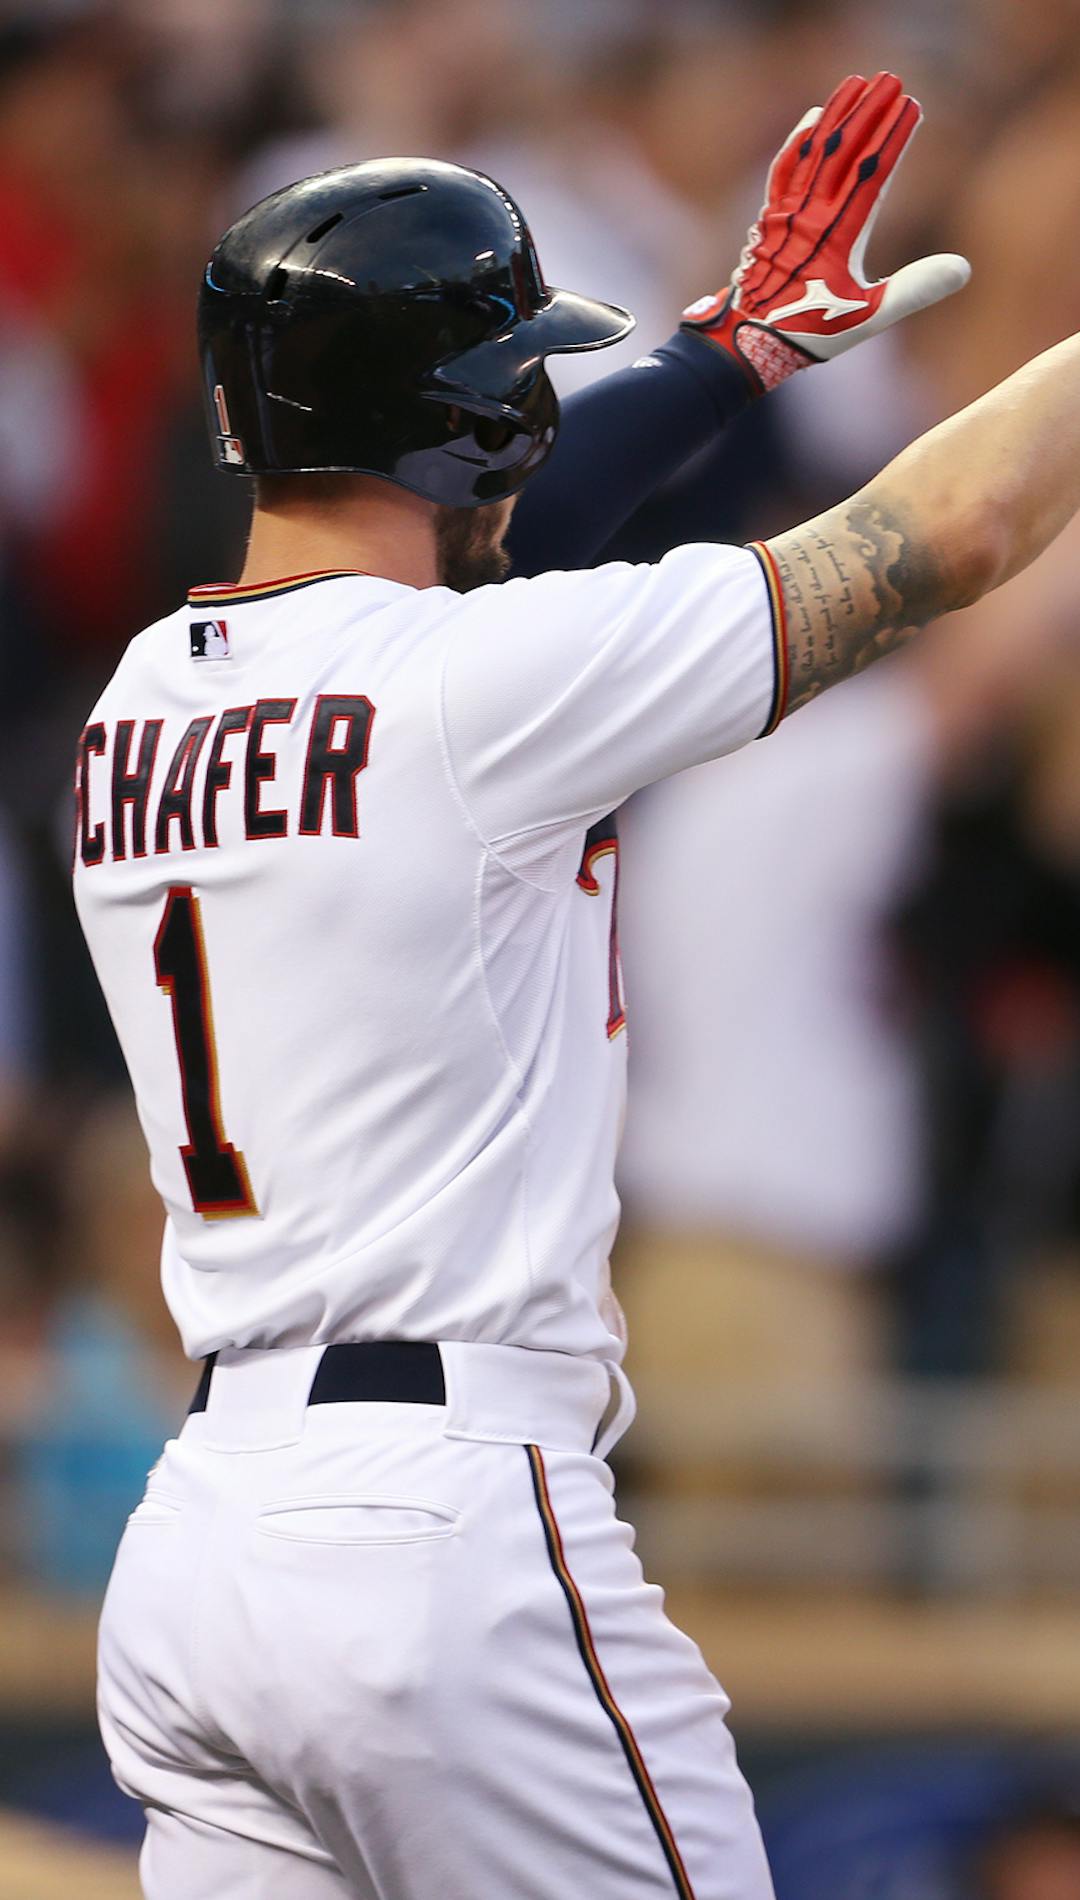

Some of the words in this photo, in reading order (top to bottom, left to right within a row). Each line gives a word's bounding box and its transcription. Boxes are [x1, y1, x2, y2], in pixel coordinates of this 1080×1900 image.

[213, 384, 231, 436] 1
[74, 694, 376, 868] CHAFER
[153, 886, 262, 1221] 1
